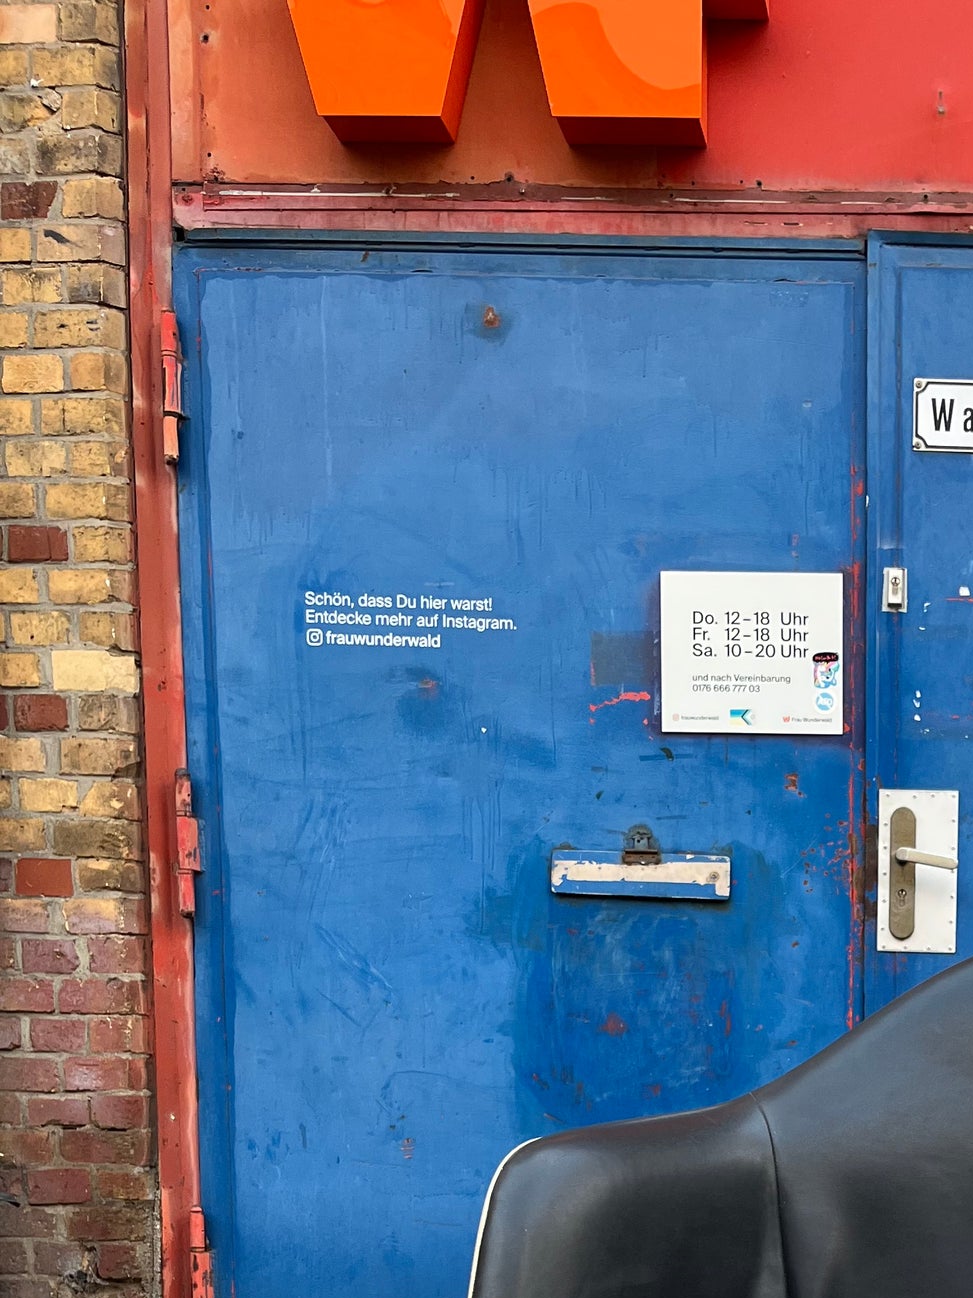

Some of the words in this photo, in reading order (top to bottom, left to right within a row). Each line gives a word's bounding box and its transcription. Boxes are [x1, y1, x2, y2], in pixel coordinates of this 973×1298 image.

[304, 591, 354, 609] Schön,
[358, 592, 392, 608] dass
[396, 594, 416, 609] Du
[420, 595, 447, 610] hier
[450, 597, 493, 611] warst!
[305, 609, 372, 626] Entdecke
[375, 612, 413, 627] mehr
[416, 613, 438, 628] auf
[442, 614, 518, 632] Instagram.
[692, 611, 718, 625] Do.
[780, 612, 809, 626] Uhr
[326, 630, 441, 648] frauwunderwald
[692, 627, 711, 641] Fr.
[780, 628, 809, 642] Uhr
[692, 643, 717, 657] Sa.
[780, 644, 809, 658] Uhr
[692, 674, 709, 682] und
[710, 674, 732, 682] nach
[733, 674, 791, 684] Vereinbarung
[692, 685, 712, 693] 0176
[713, 685, 731, 693] 666
[748, 685, 761, 693] 03
